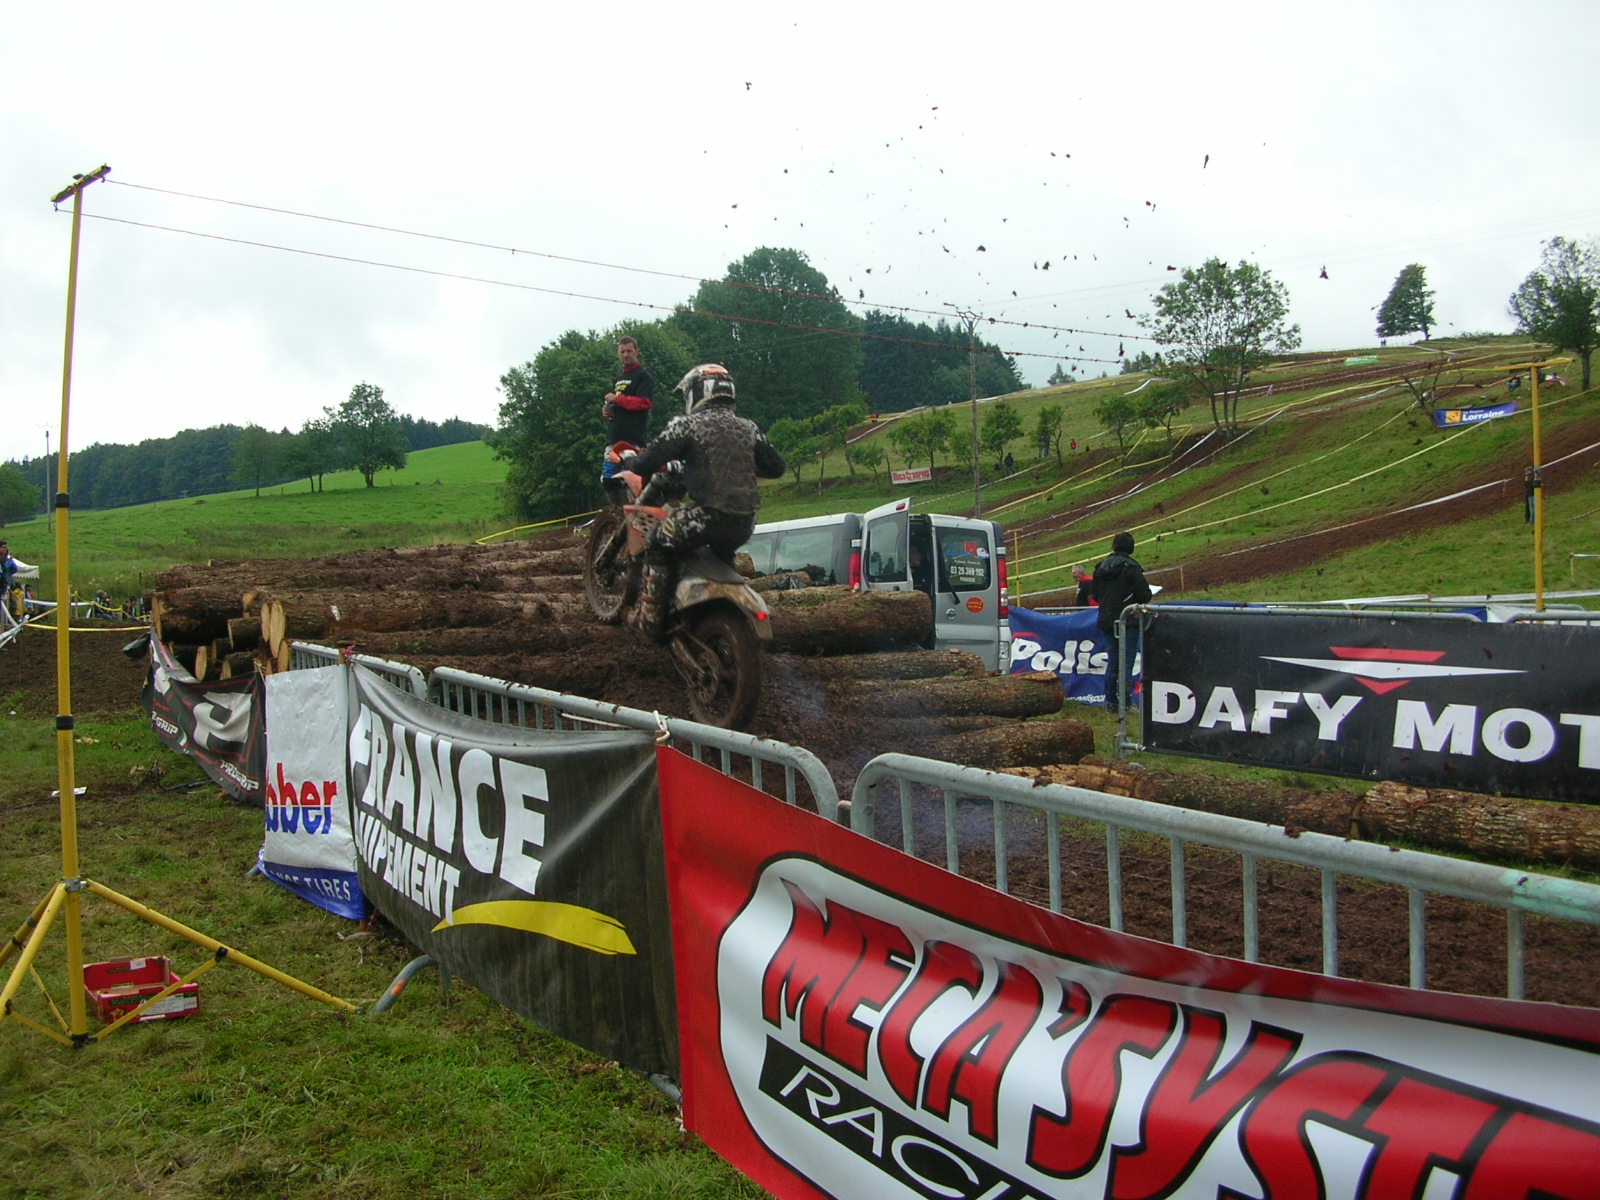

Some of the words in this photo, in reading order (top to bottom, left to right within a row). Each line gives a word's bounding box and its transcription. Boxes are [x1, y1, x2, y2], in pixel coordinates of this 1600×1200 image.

[1462, 410, 1505, 422] Lorraine
[1151, 681, 1363, 741] DAFY
[350, 703, 549, 896] FRANCE
